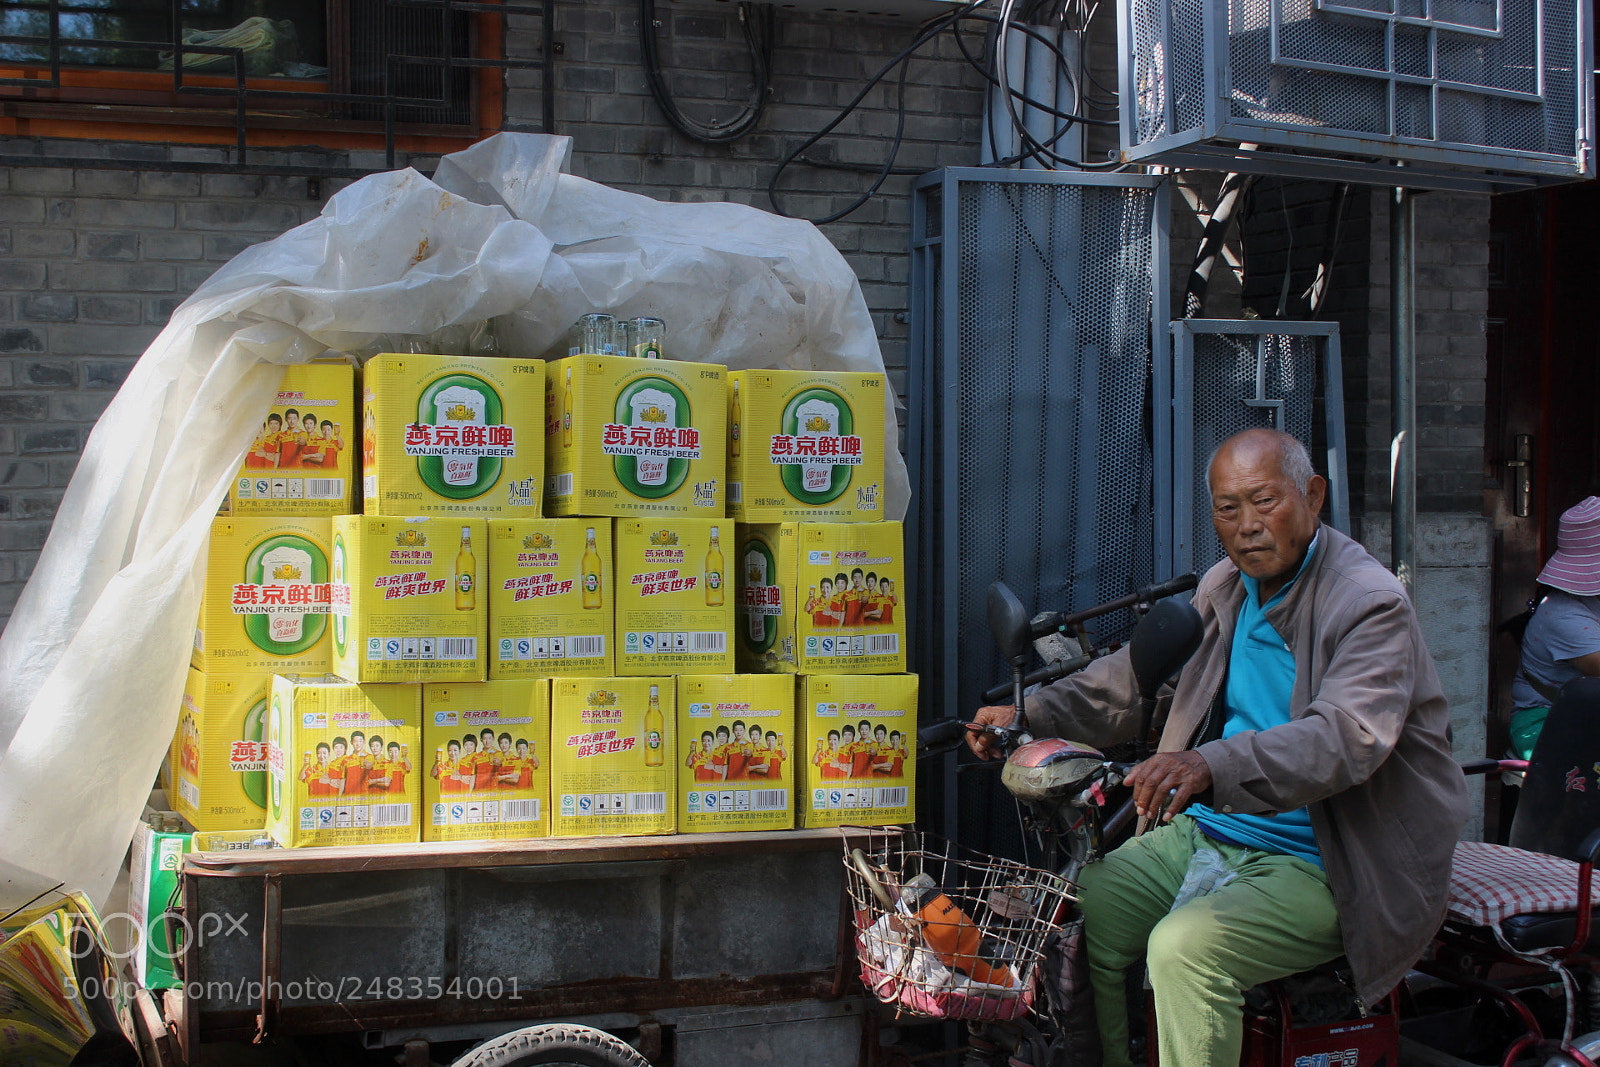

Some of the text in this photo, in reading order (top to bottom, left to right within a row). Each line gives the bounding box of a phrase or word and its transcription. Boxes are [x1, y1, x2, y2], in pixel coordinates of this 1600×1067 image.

[276, 391, 305, 399] 京啤酒
[405, 424, 515, 448] 燕京鲜啤
[603, 424, 701, 450] 燕京鲜啤
[405, 446, 514, 457] YANJING FRESH BEER
[771, 435, 862, 456] 燕京鲜啤
[604, 446, 700, 459] YANJING FRESH BEER
[771, 456, 862, 465] YANJING FRESH BEER
[508, 497, 534, 507] Crystal
[693, 498, 716, 508] Crystal
[856, 501, 877, 511] Crystal
[389, 549, 433, 560] 燕京啤酒
[517, 552, 559, 562] 燕京啤酒
[644, 549, 685, 558] 燕京啤酒
[374, 571, 427, 588] 燕京鲜啤
[503, 573, 554, 590] 燕京鲜啤
[631, 569, 680, 585] 燕京鲜啤
[384, 579, 448, 601] 鲜爽世界
[514, 580, 574, 602] 鲜爽世界
[640, 576, 698, 597] 鲜爽世界
[233, 606, 331, 614] YANJING FRESH BEE
[581, 709, 623, 718] 燕京啤酒
[567, 730, 617, 746] 燕京鲜啤
[577, 737, 637, 759] 鲜爽世界
